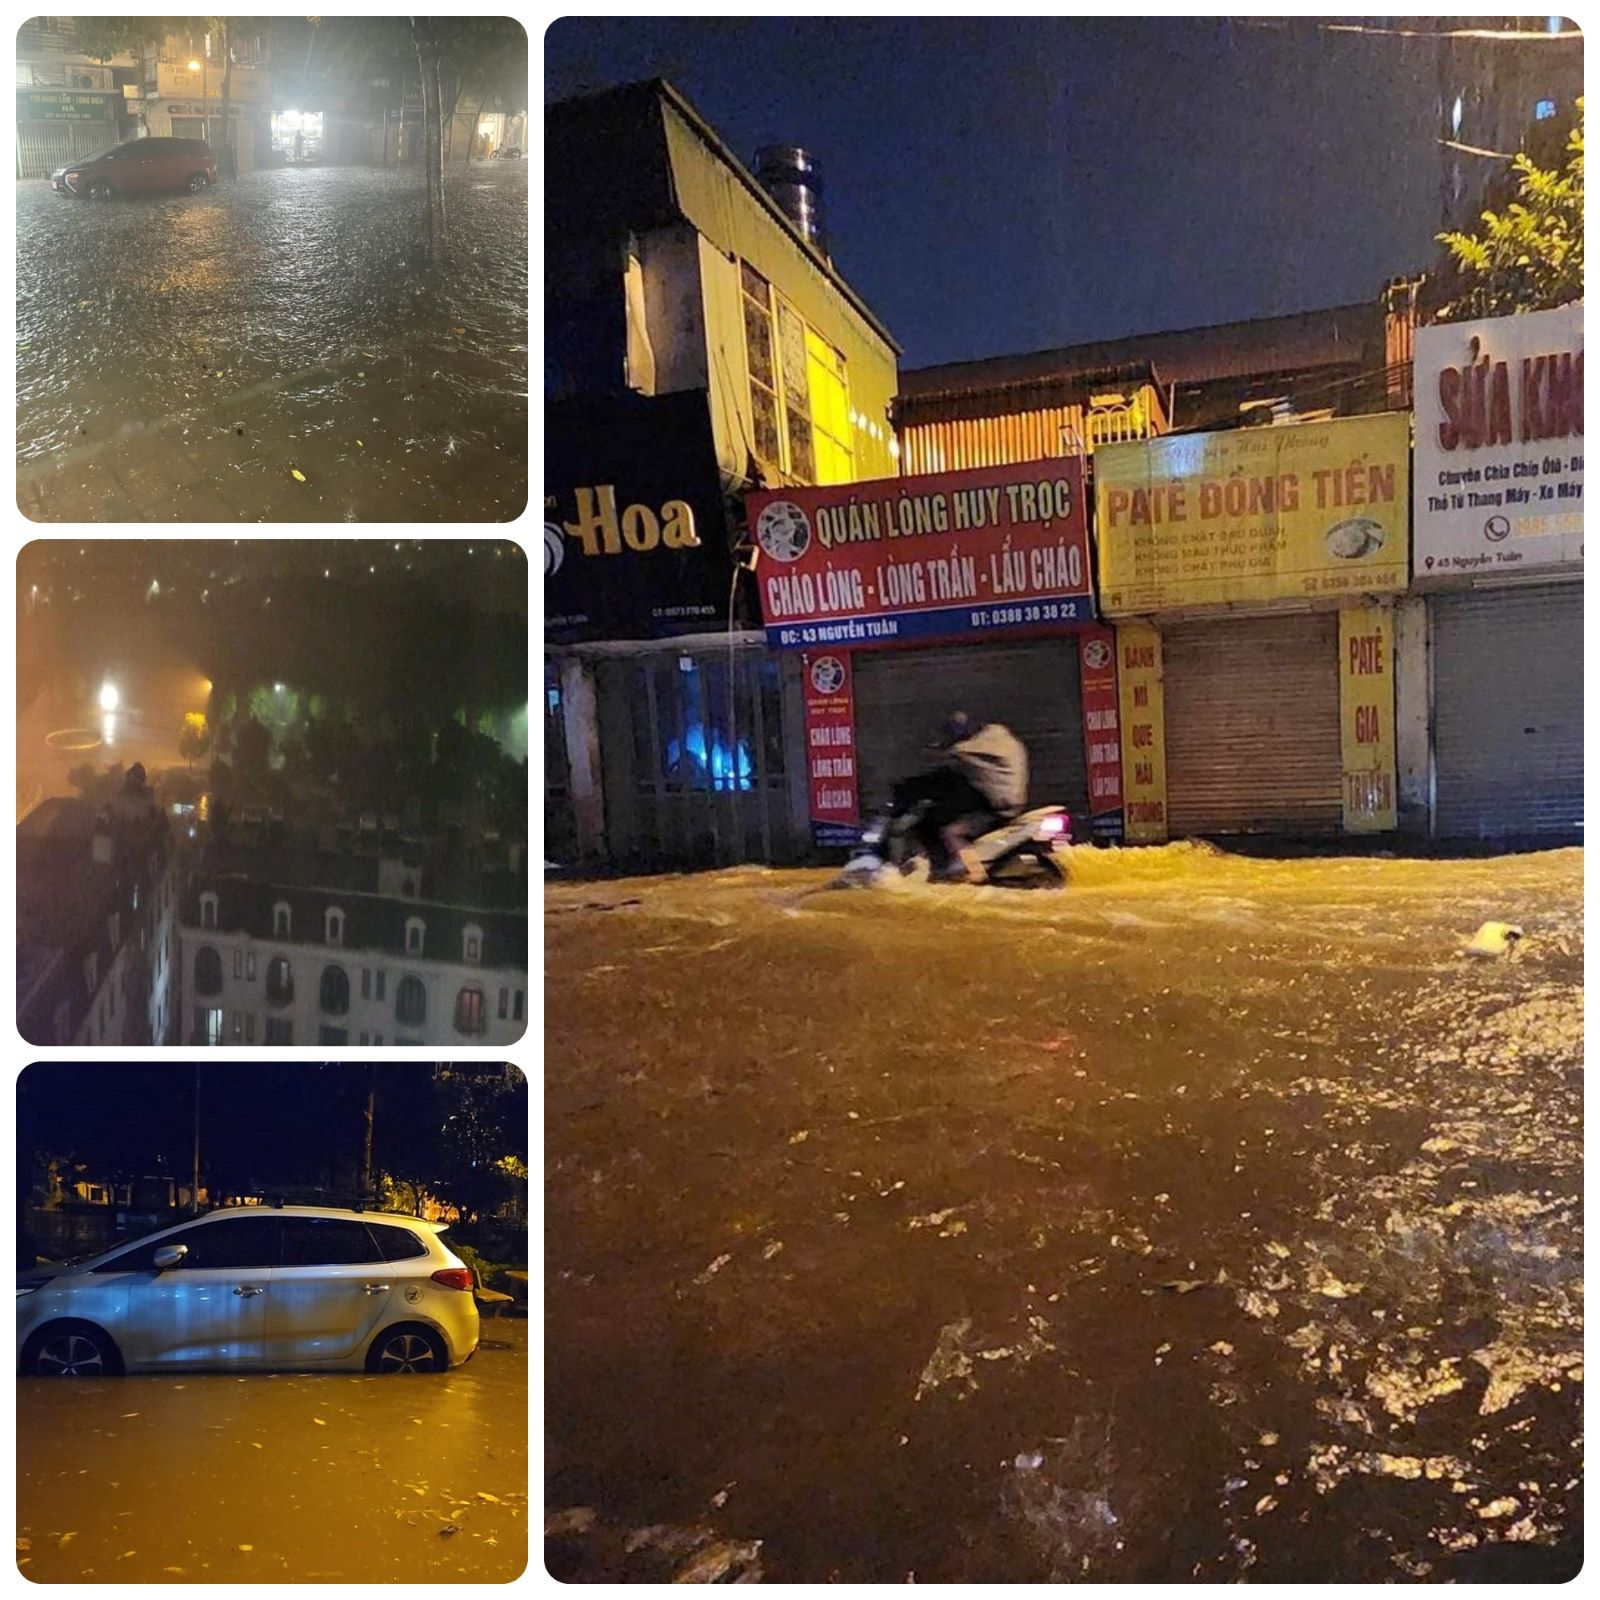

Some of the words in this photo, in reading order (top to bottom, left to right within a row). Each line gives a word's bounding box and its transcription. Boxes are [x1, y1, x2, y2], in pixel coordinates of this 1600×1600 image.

[1439, 335, 1512, 451] SỬA
[1312, 452, 1395, 510] TIẾN
[1485, 463, 1510, 482] Chìa
[1513, 459, 1539, 478] Chíp
[1468, 492, 1502, 507] Thang
[1506, 487, 1530, 504] Máy
[1539, 485, 1553, 500] Xe
[1558, 481, 1582, 499] Máy
[563, 484, 701, 556] Hoa
[816, 497, 881, 549] QUÁN
[885, 489, 948, 538] LÒNG
[953, 487, 1000, 530] HUY
[1006, 479, 1071, 528] TRỌC
[767, 566, 815, 617] CHÁO
[816, 560, 865, 612] LÒNG
[877, 554, 926, 606] LÒNG
[990, 534, 1026, 594] LẨU
[1031, 536, 1081, 590] CHÁO
[802, 626, 817, 642] 43
[818, 619, 865, 641] NGUYỄN
[866, 618, 898, 637] TUÂN
[1025, 606, 1040, 621] 38
[1043, 604, 1058, 619] 38
[1060, 603, 1076, 618] 22
[1132, 724, 1153, 749] QUE
[1356, 705, 1380, 743] GIA
